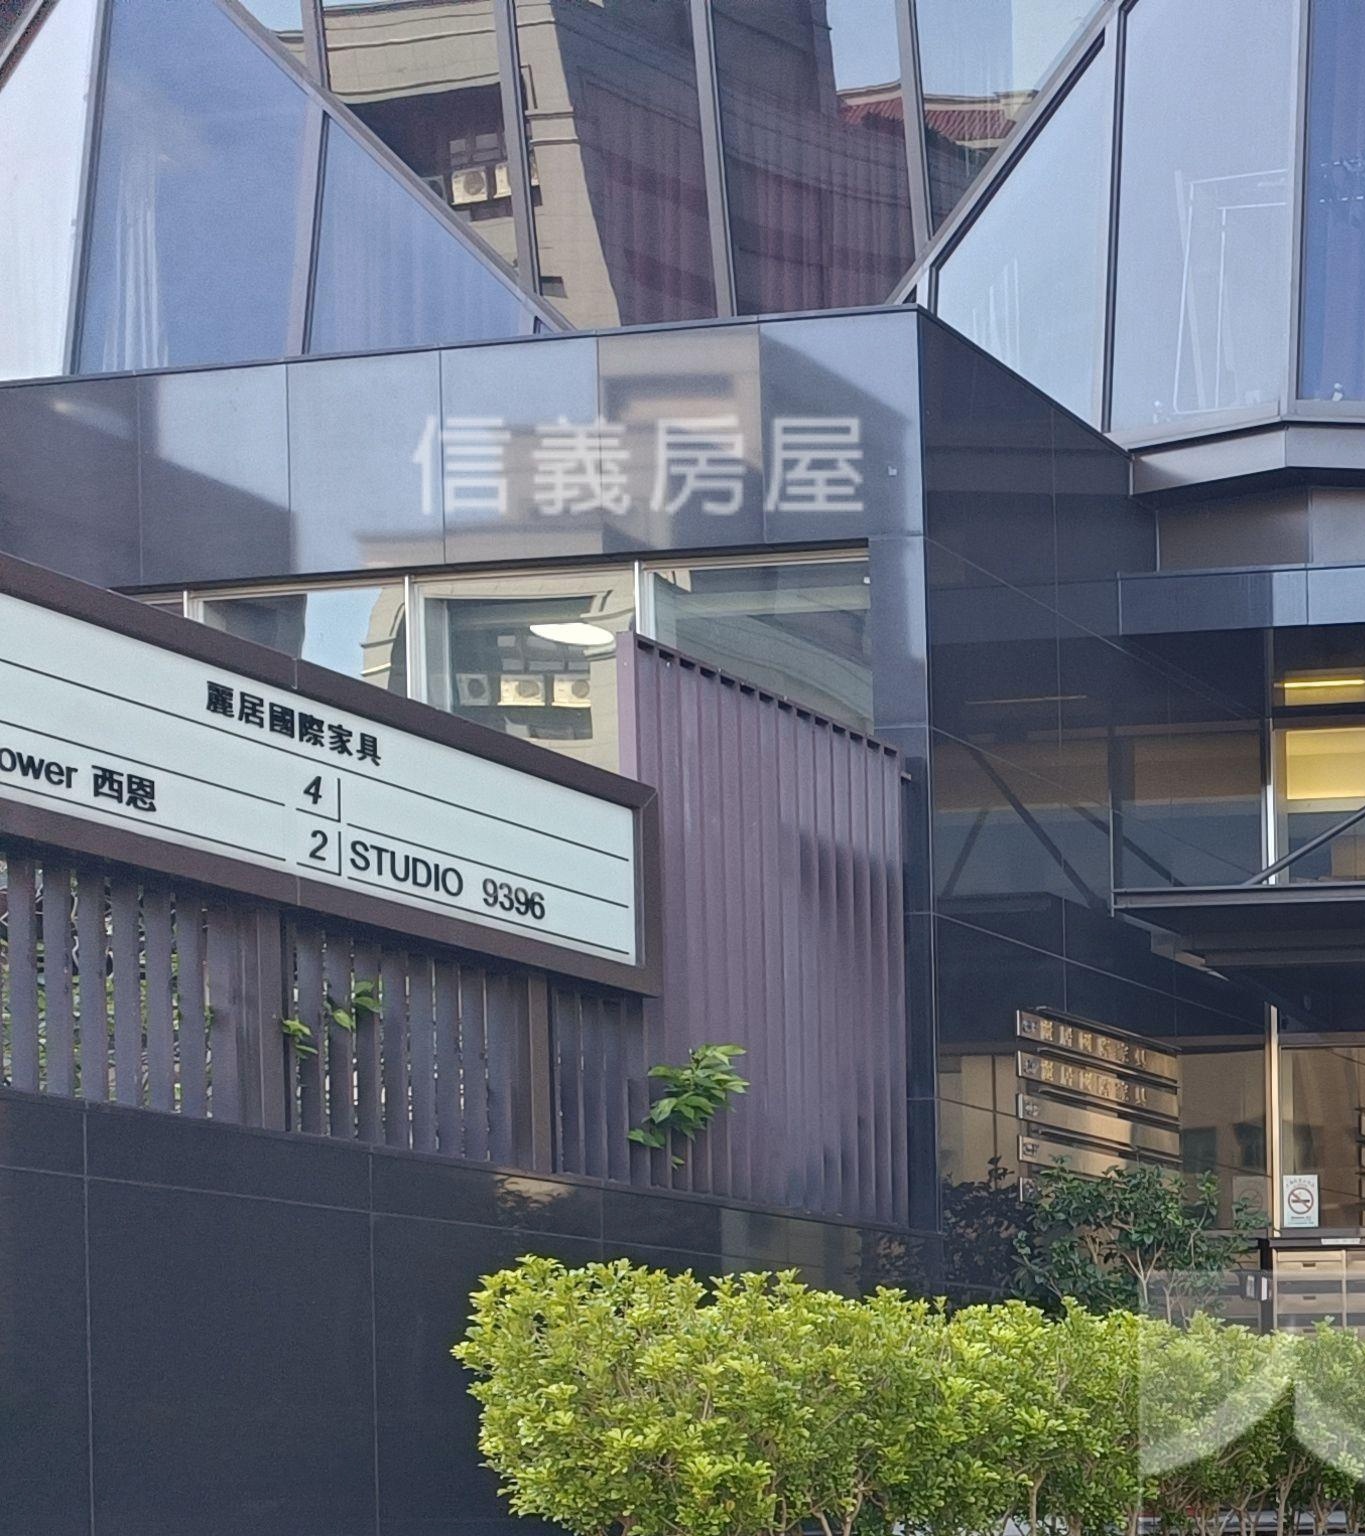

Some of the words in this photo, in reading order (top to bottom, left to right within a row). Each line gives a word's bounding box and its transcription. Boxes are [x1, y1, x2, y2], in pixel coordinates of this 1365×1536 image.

[206, 681, 382, 767] 麗居國際家具
[91, 765, 156, 812] 西恩
[303, 776, 322, 804] 4
[309, 830, 328, 861] 2
[350, 840, 463, 897] STUDIO
[482, 878, 546, 920] 9396
